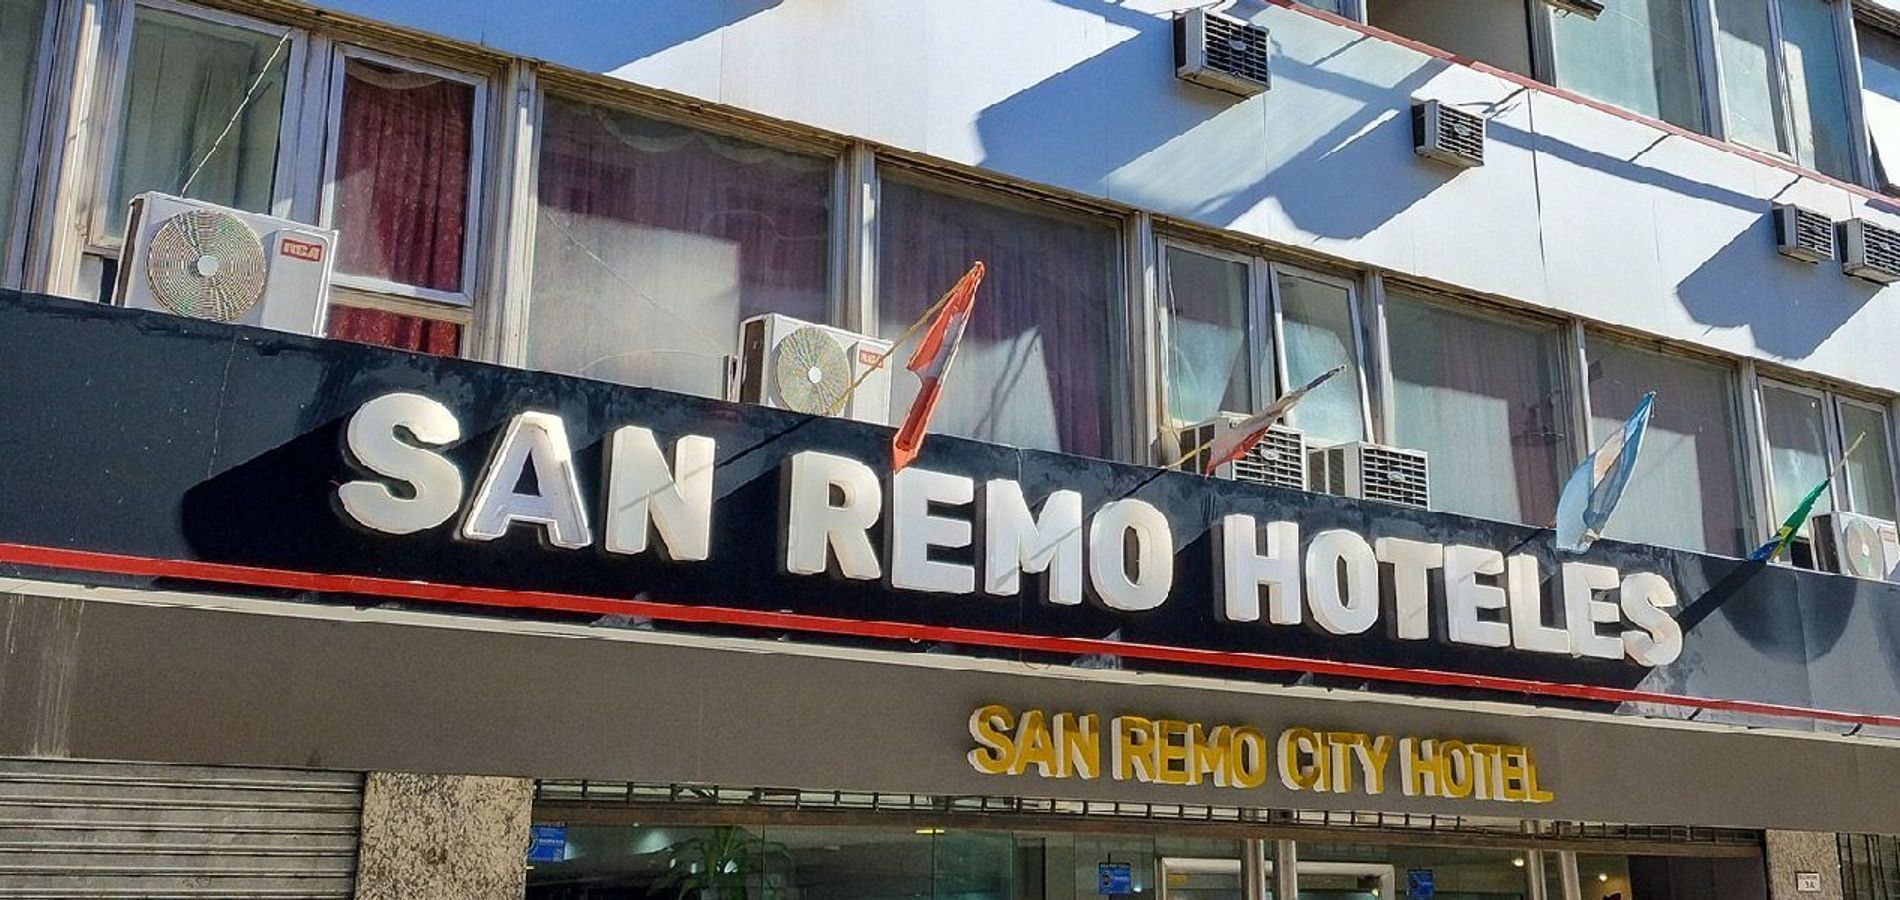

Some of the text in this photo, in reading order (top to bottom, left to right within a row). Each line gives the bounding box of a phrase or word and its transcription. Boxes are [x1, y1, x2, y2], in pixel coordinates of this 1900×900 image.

[283, 242, 320, 260] RCA
[338, 391, 1684, 668] SAN REMO HOTELES
[966, 704, 1556, 804] SAN REMO CITY HOTEL
